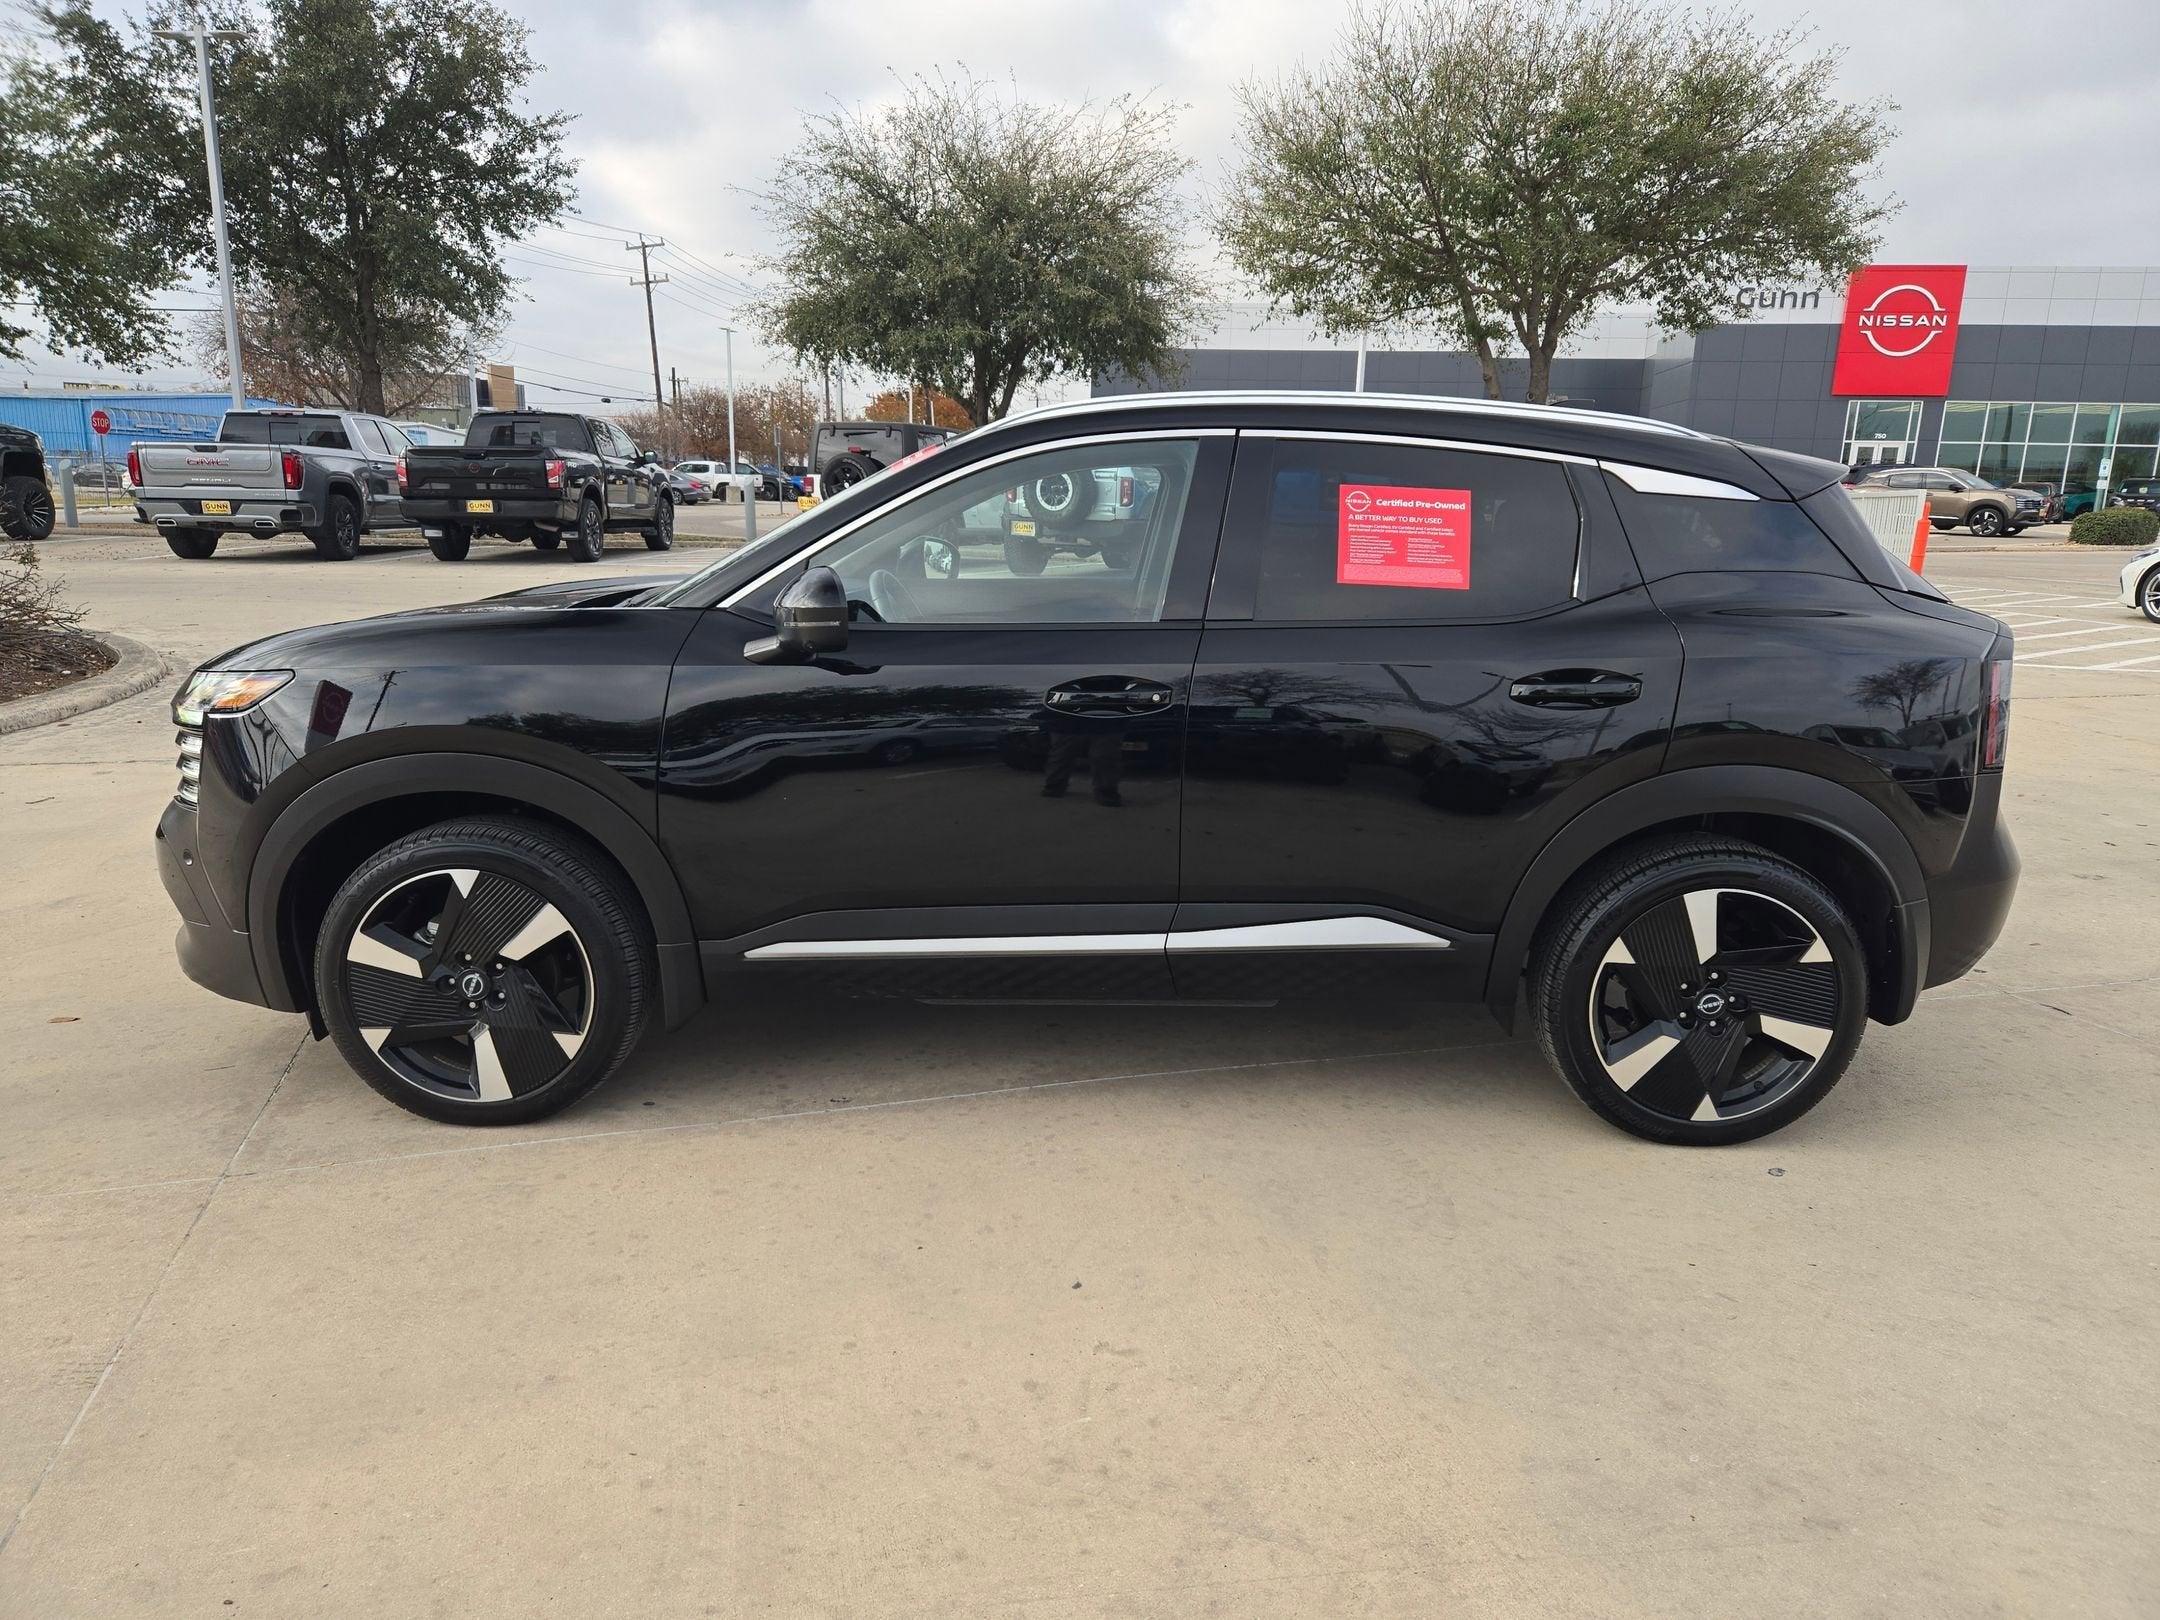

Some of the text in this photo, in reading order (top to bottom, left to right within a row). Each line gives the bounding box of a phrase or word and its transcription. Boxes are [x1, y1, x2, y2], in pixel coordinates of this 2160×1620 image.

[1736, 287, 1820, 309] Gunn
[1859, 314, 1948, 327] NISSAN
[92, 417, 109, 428] STOP
[185, 456, 230, 467] GMC
[1376, 499, 1466, 510] Certified Pre-Owned
[1014, 522, 1034, 531] GUNN
